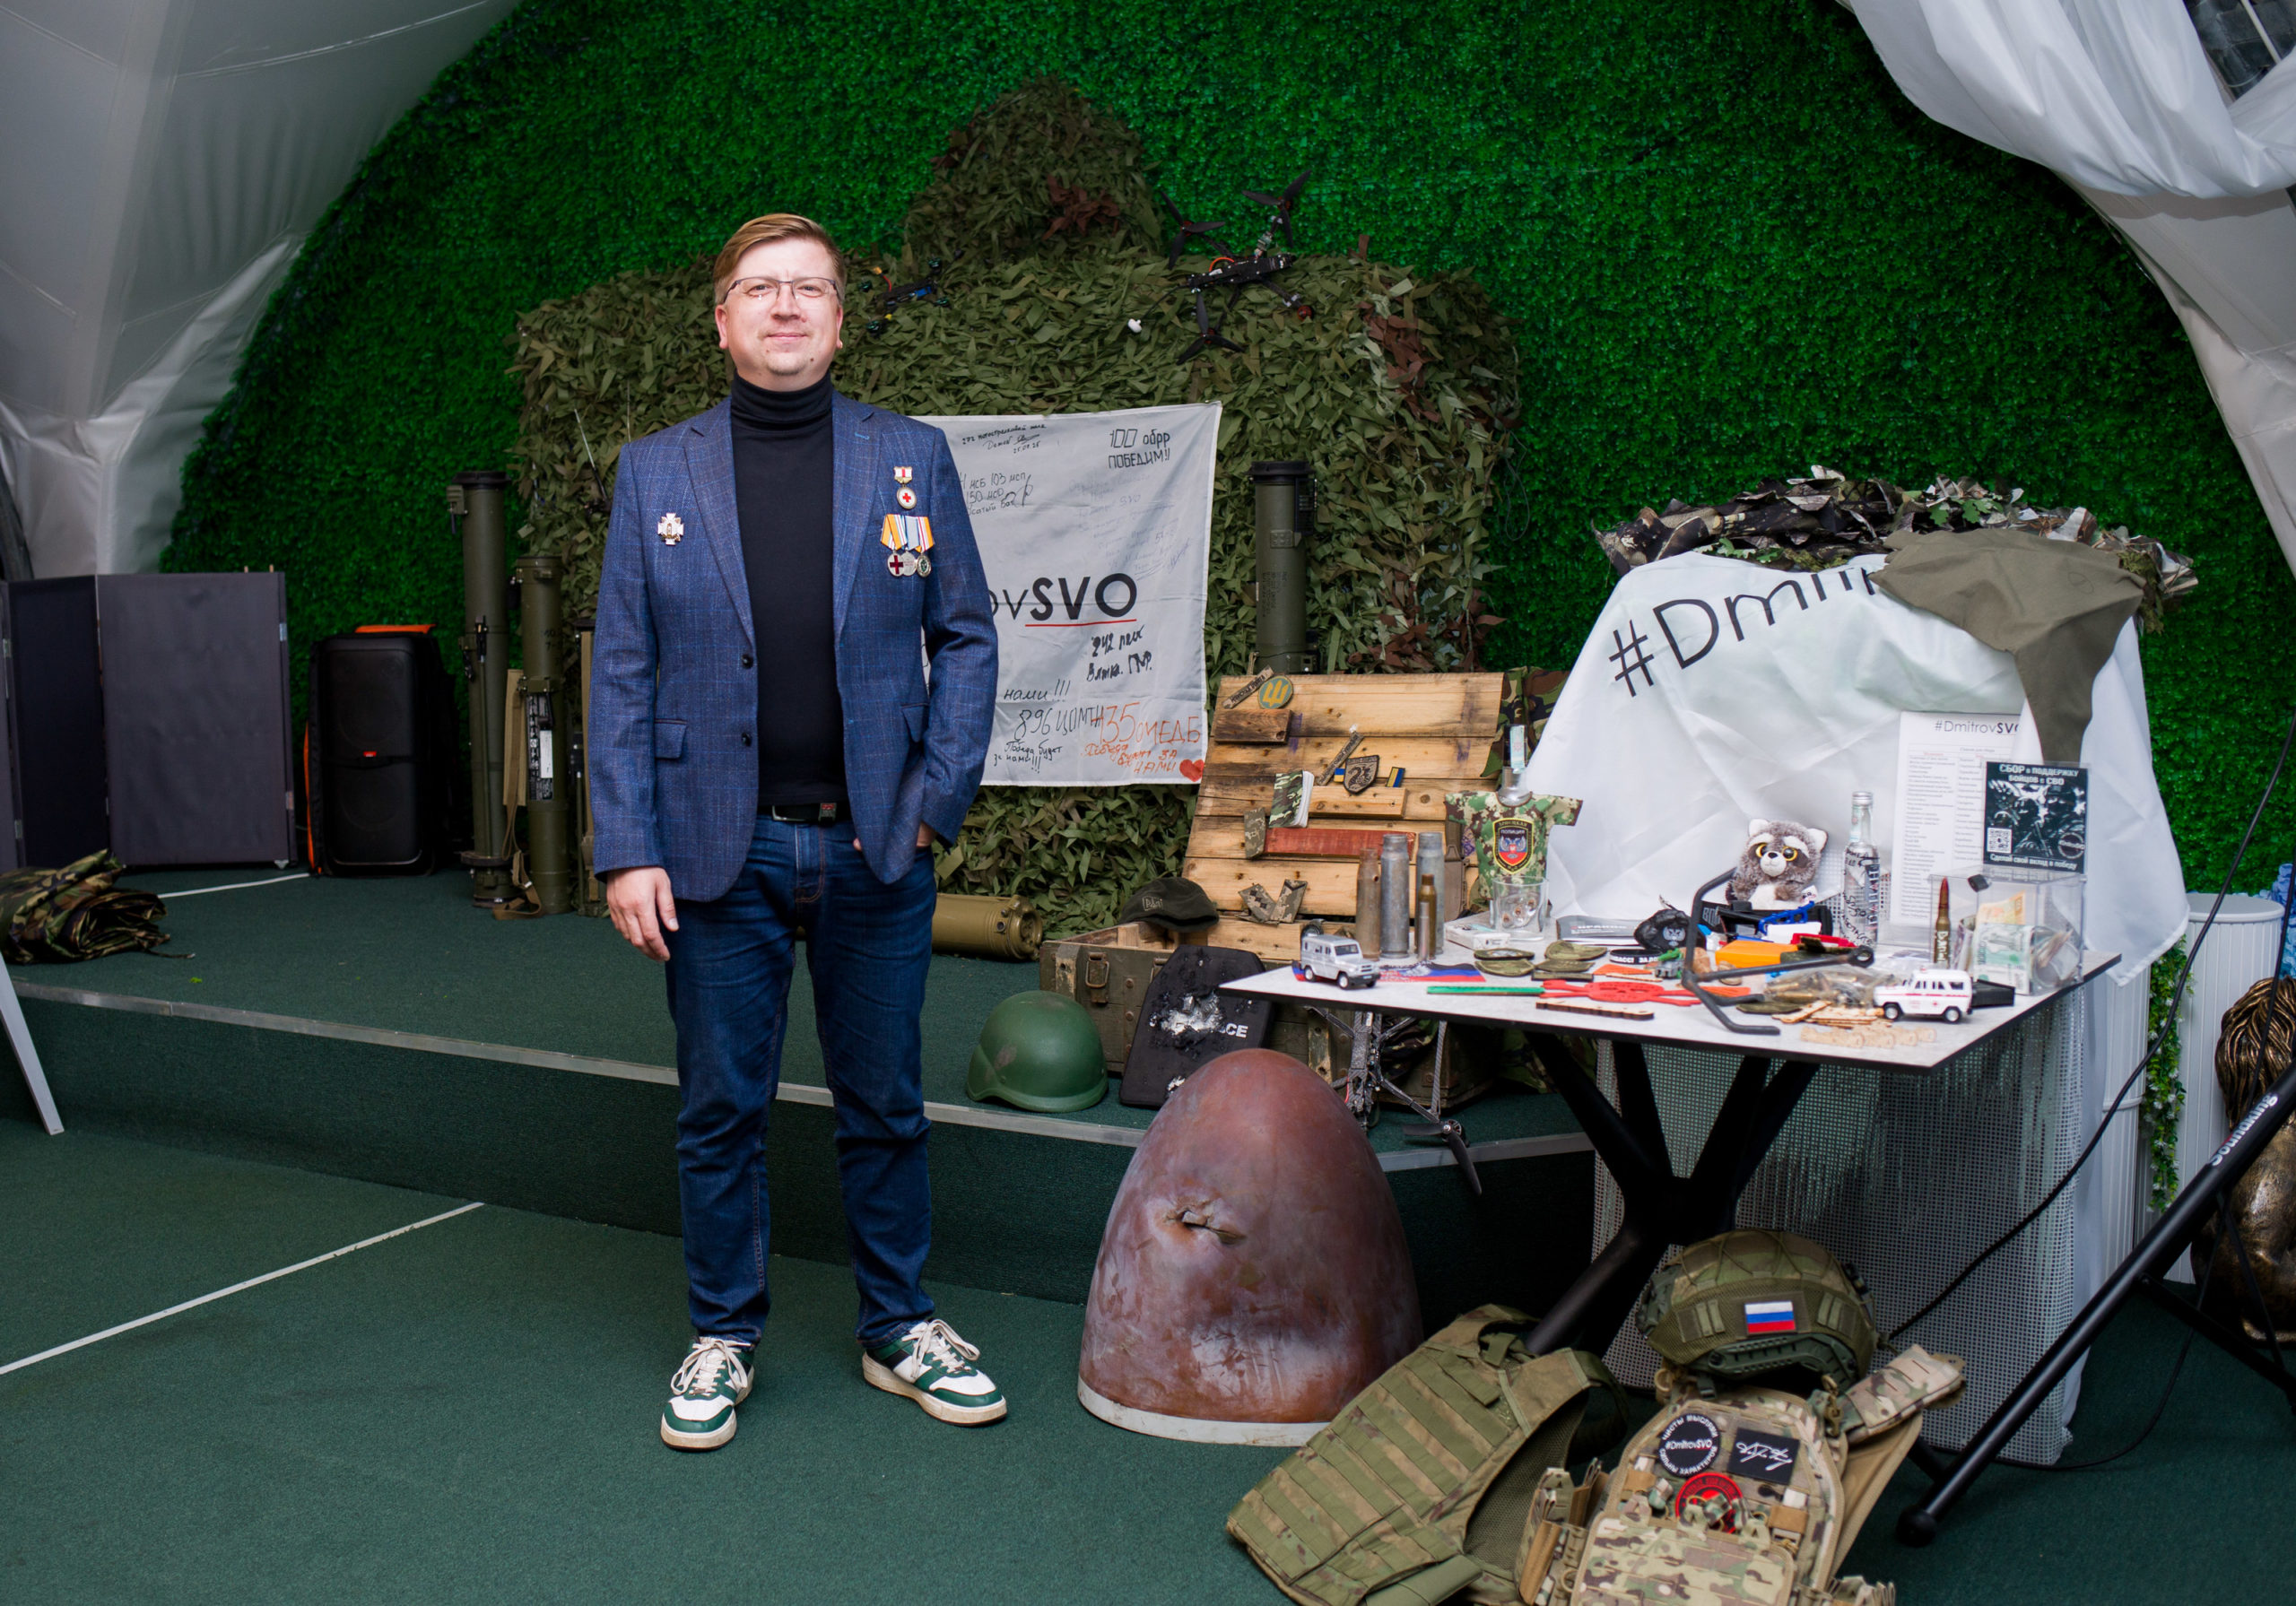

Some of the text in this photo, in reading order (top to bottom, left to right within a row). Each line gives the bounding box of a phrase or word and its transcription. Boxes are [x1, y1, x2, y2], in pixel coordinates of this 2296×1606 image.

[1109, 429, 1170, 449] 100 обрр
[991, 473, 1006, 486] 103
[966, 490, 983, 505] 150
[1014, 707, 1053, 742] 896
[1998, 763, 2025, 773] СБОР
[2031, 768, 2079, 777] ПОДДЕРЖКУ
[2008, 775, 2039, 784] БОЙЦОВ
[2046, 777, 2065, 786] СВО
[2210, 1094, 2279, 1166] Soundking
[1661, 1414, 1719, 1440] ЧИСТЫ МЫСЛЯМИ
[1665, 1438, 1713, 1450] #DmitrovSVO
